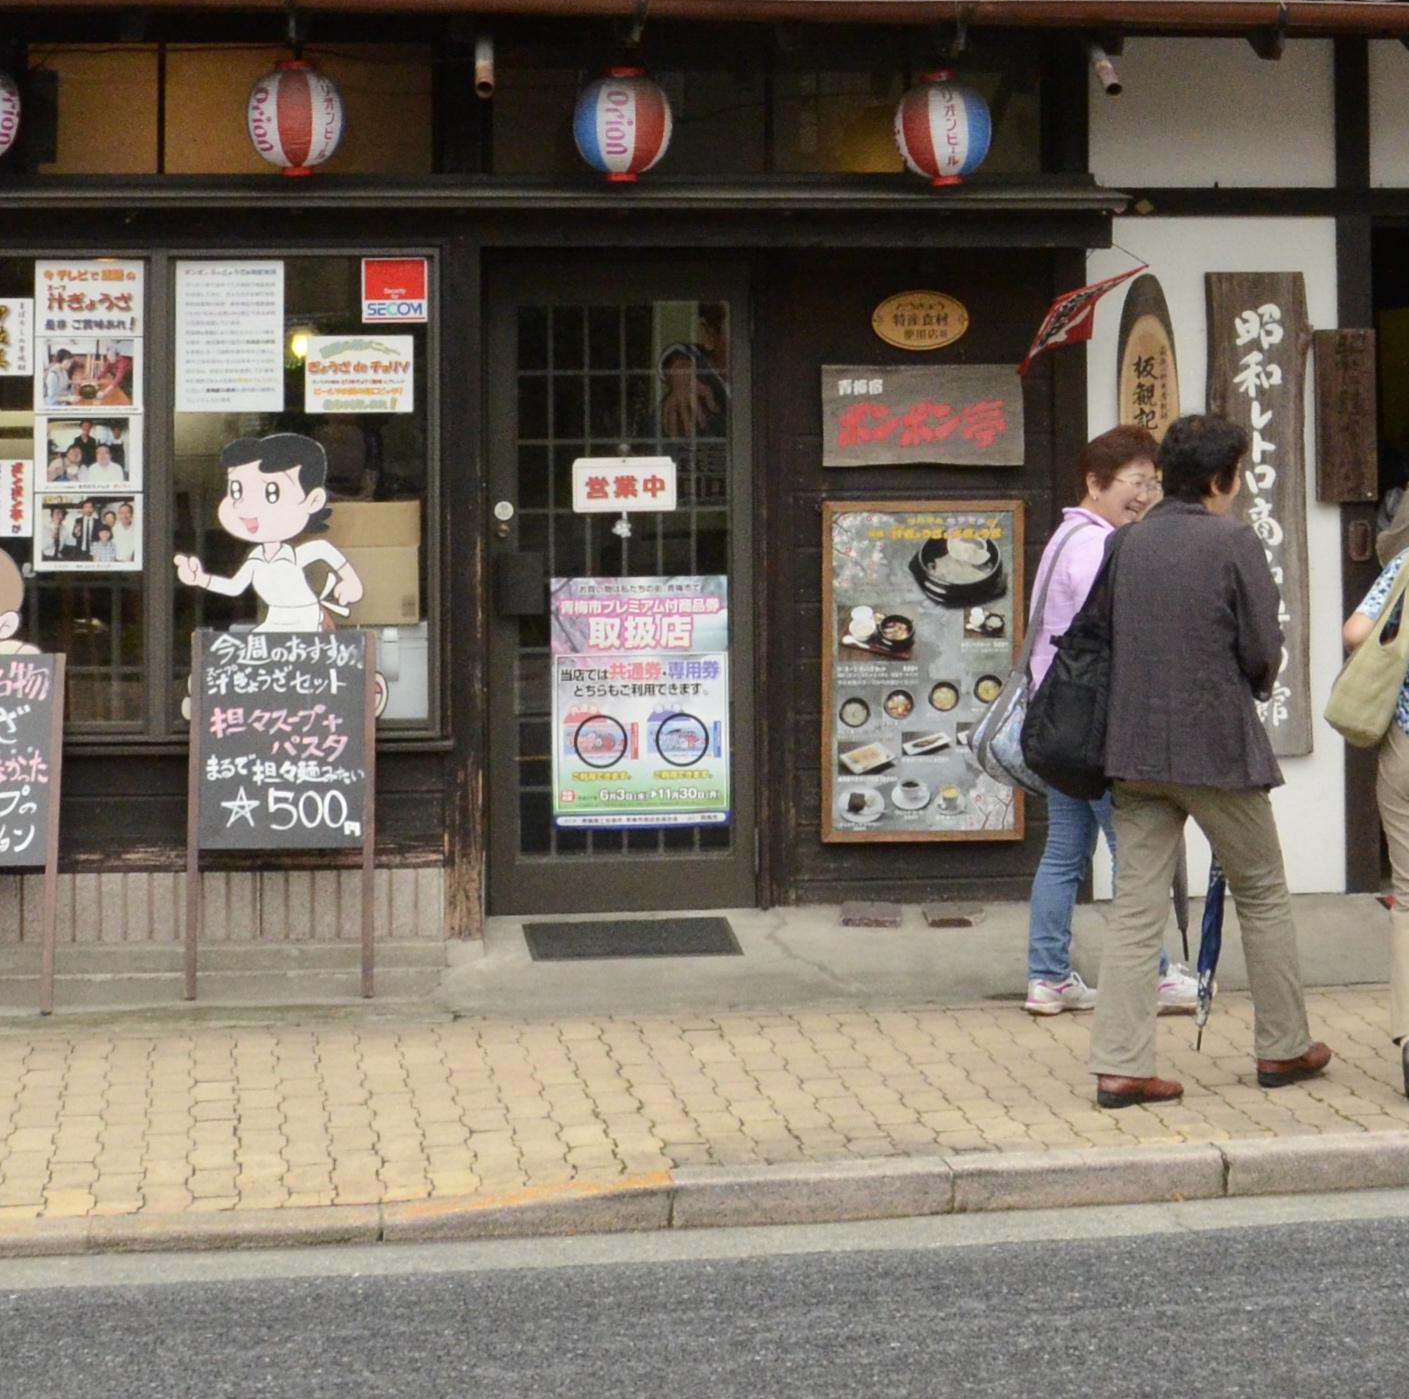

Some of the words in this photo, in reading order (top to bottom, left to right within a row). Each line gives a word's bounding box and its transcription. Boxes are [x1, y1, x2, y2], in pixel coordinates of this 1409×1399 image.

[252, 87, 274, 153] Orion
[605, 91, 633, 155] Orion
[47, 292, 133, 312] 汁ぎょうざ
[367, 302, 423, 316] SECOM
[585, 474, 666, 500] 営業中
[1233, 303, 1291, 728] 昭和レトロ商館
[559, 598, 721, 615] 青梅市プレミアム付商品券
[588, 615, 692, 650] 取扱店
[271, 735, 349, 762] パスタ
